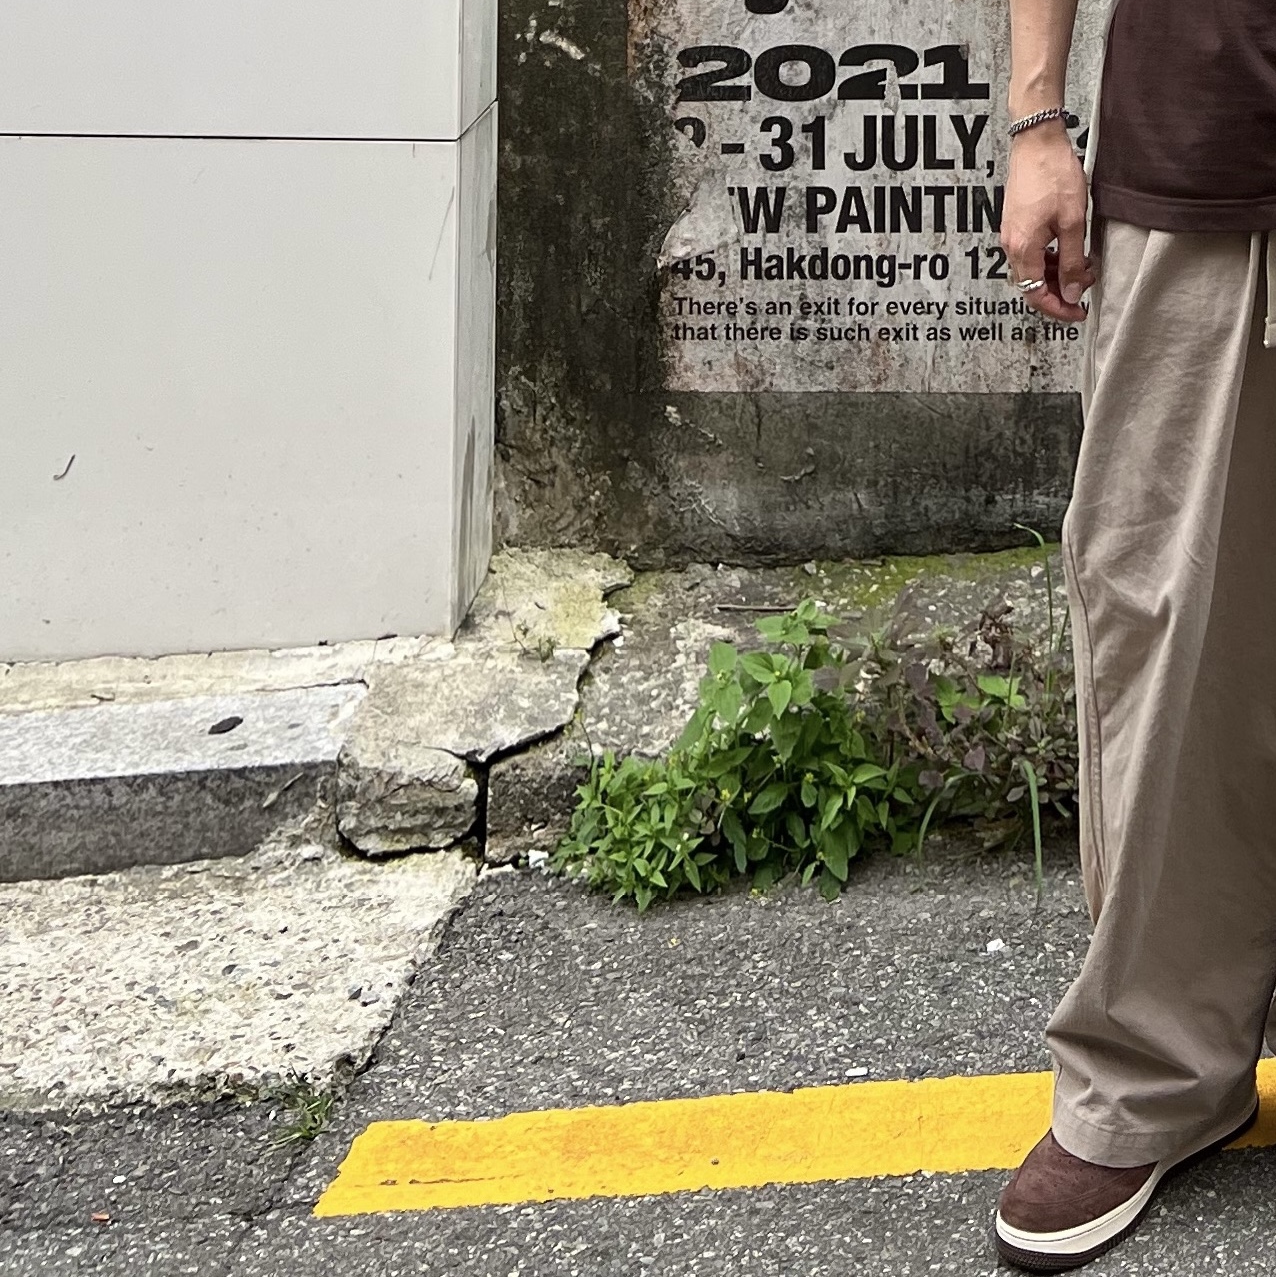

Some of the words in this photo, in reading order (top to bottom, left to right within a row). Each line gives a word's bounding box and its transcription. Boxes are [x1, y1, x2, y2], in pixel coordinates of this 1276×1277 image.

[676, 43, 990, 102] 2021
[758, 114, 826, 172] 31
[843, 113, 995, 178] JULY,
[727, 186, 787, 234] W
[805, 185, 1005, 234] PAINTIN
[740, 246, 950, 288] Hakdong-ro
[965, 246, 1008, 280] 12
[673, 296, 757, 316] There's
[765, 300, 792, 316] an
[800, 297, 841, 316] exit
[848, 296, 879, 316] for
[886, 300, 949, 320] every
[955, 296, 1036, 316] situati
[673, 323, 718, 341] that
[724, 323, 782, 341] there
[790, 323, 808, 341] is
[816, 323, 870, 341] such
[878, 323, 919, 341] exit
[926, 326, 952, 341] as
[959, 323, 1003, 341] well
[1044, 323, 1079, 341] the
